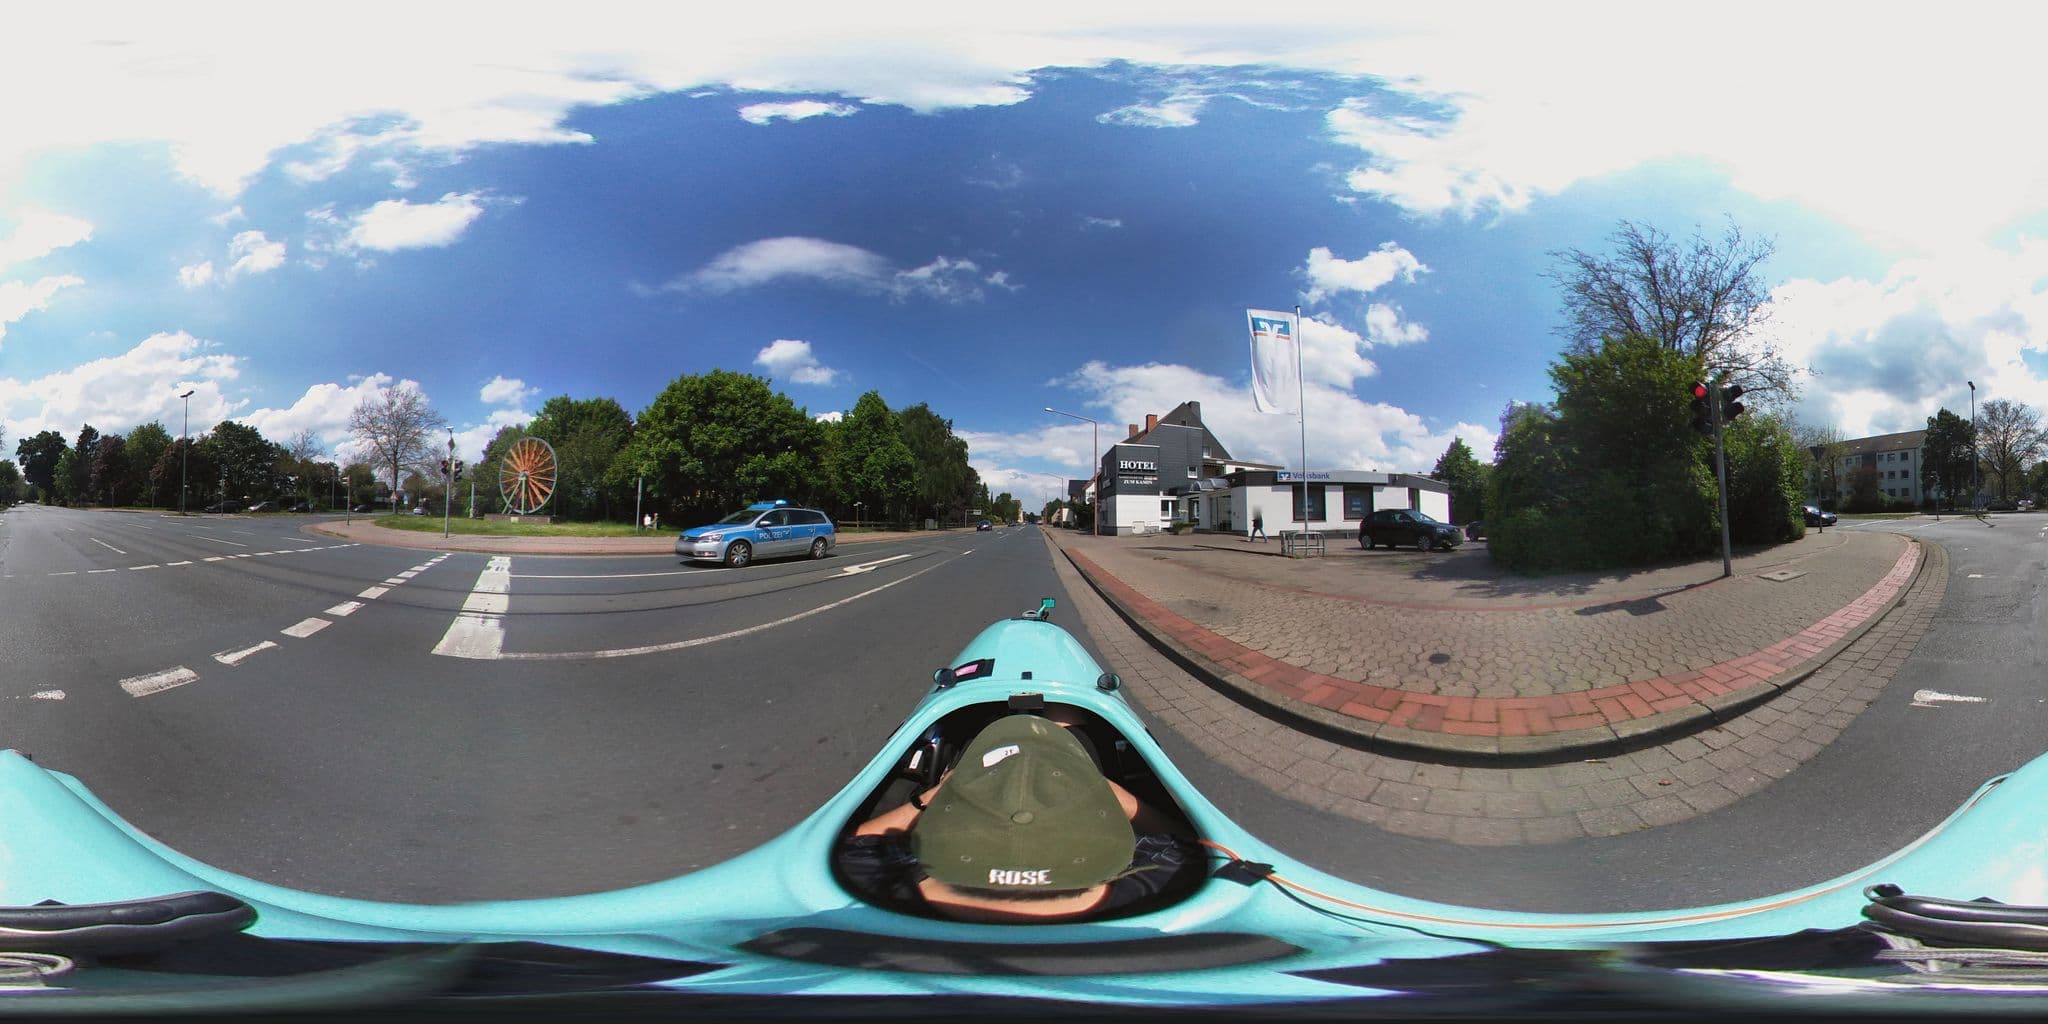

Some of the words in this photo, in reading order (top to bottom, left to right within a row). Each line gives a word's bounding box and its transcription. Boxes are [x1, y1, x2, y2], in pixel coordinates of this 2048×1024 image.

[1120, 460, 1157, 470] HOTEL
[1292, 472, 1330, 480] Voksbank
[989, 868, 1053, 885] ROSE
